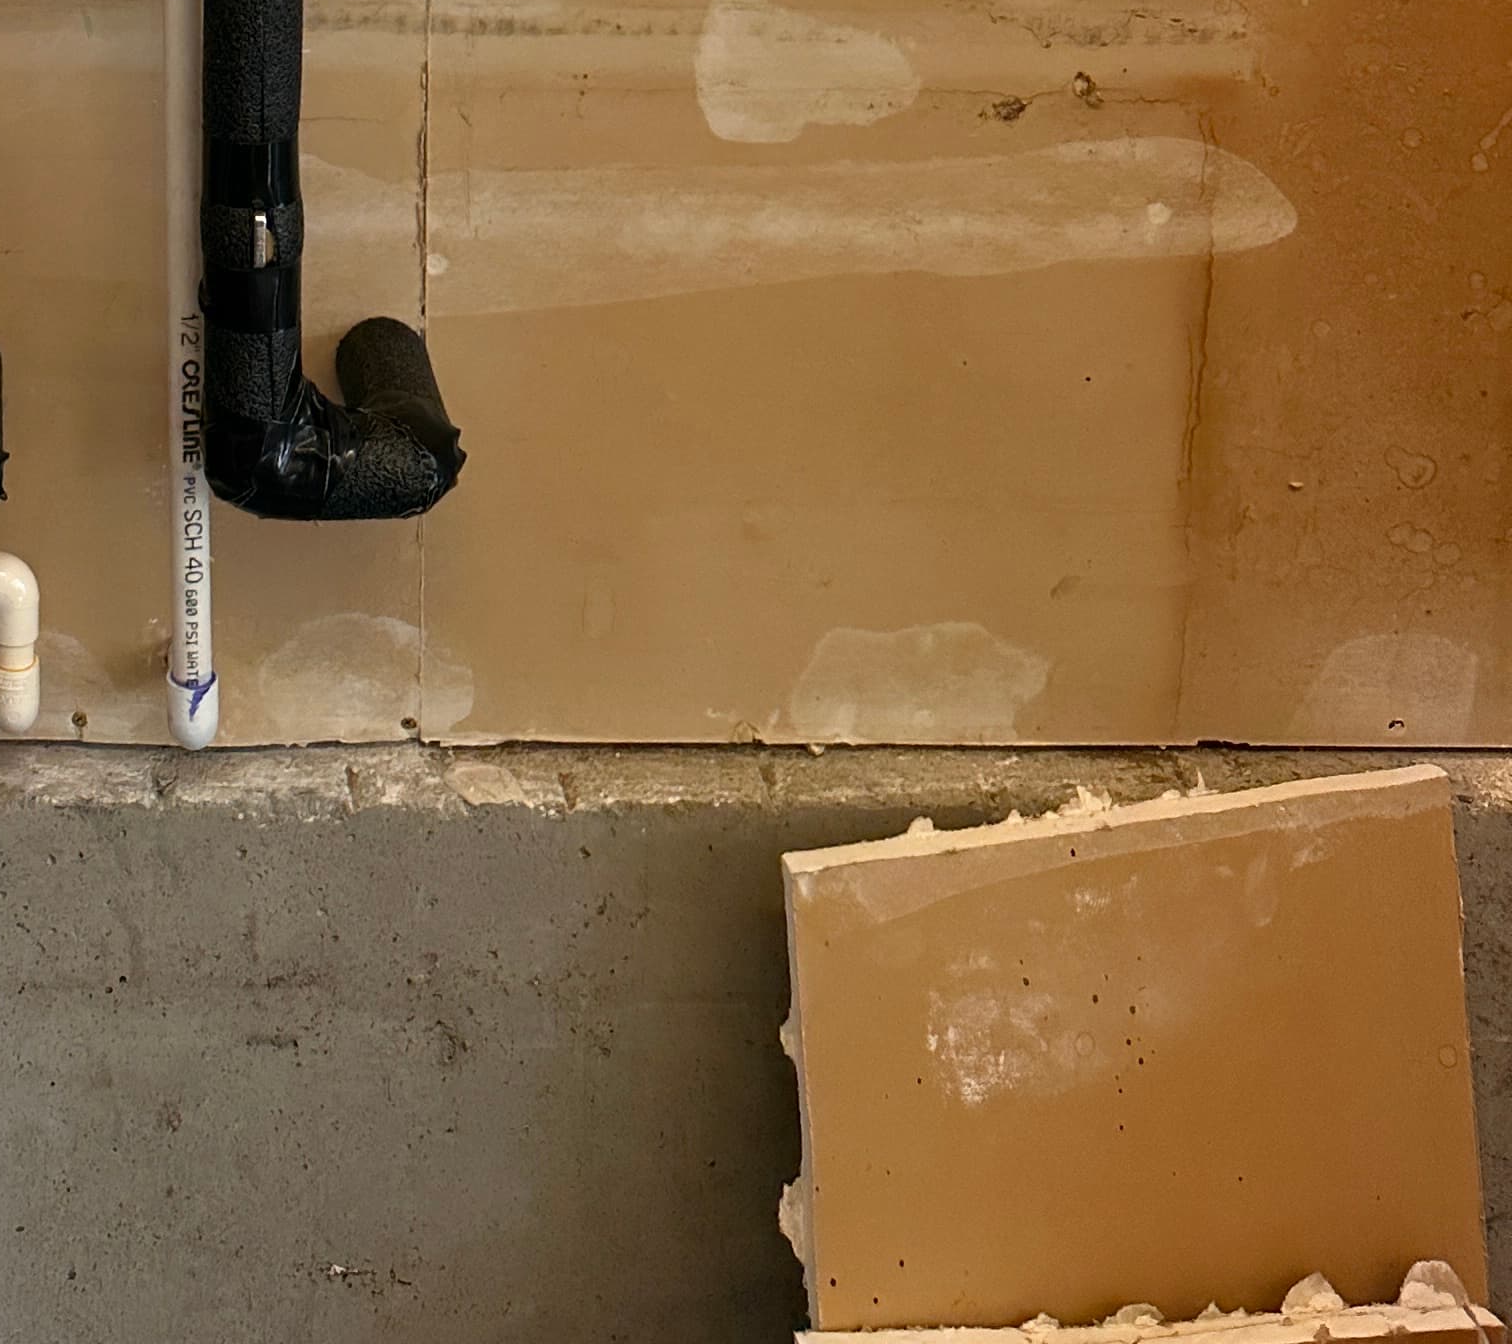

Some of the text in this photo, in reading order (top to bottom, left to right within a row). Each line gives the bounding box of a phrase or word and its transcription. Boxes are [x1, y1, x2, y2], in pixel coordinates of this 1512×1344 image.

[183, 476, 196, 504] PVC
[184, 510, 203, 552] SCH
[184, 557, 204, 585] 40
[185, 621, 199, 646] PSI
